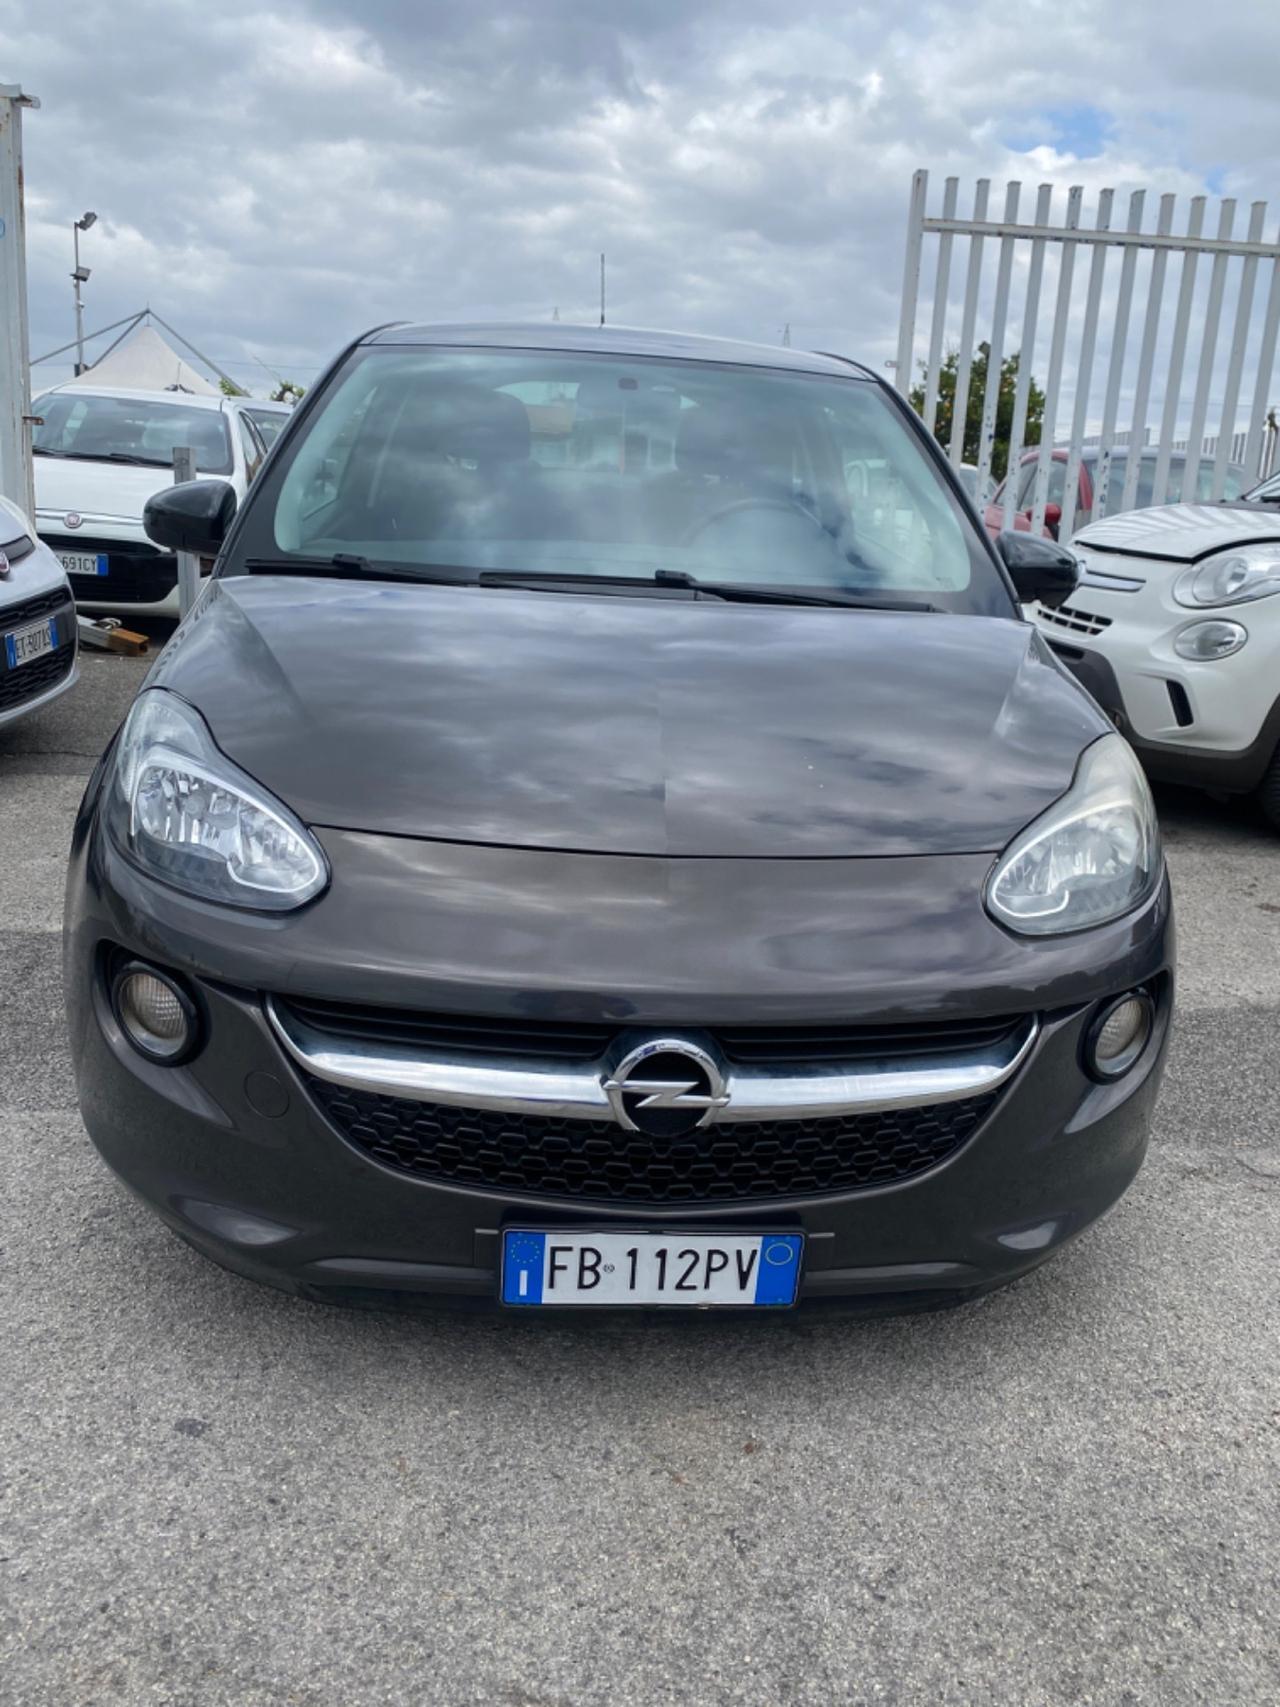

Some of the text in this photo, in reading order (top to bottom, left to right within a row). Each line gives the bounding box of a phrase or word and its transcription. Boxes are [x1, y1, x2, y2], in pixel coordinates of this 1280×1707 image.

[62, 556, 97, 571] 691CY
[548, 1246, 602, 1290] FB
[626, 1247, 758, 1291] 112PV
